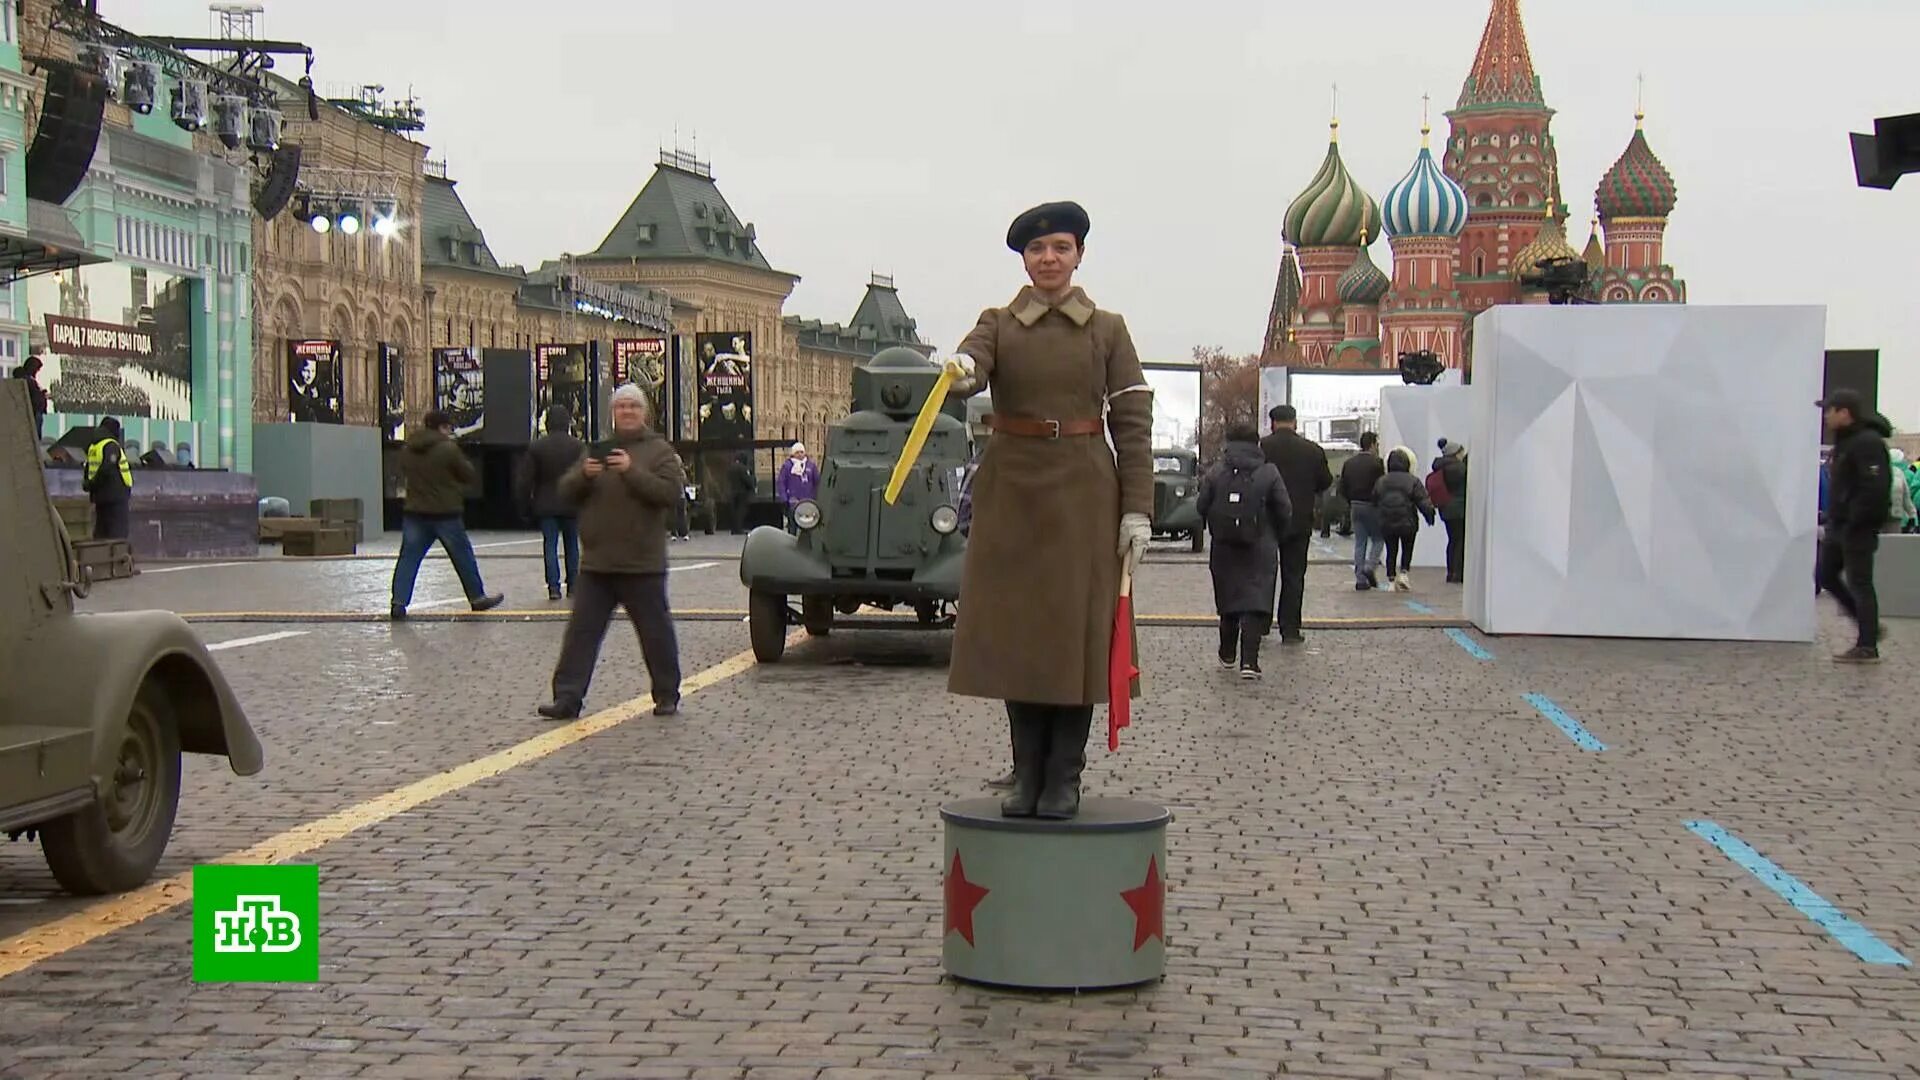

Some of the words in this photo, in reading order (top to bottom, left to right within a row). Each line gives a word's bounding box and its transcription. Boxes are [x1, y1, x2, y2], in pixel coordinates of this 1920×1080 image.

[53, 323, 80, 348] ПАРАД
[81, 328, 86, 346] 7
[87, 328, 117, 349] НОЯБРЯ
[118, 331, 132, 351] 1941
[133, 333, 152, 355] ГОДА
[296, 344, 332, 355] ЖЕНЩИНЫ
[626, 342, 636, 351] НА
[636, 342, 660, 351] ПОБЕДУ
[706, 376, 745, 386] ЖЕНЩИНЫ
[716, 386, 733, 394] ТЫЛА
